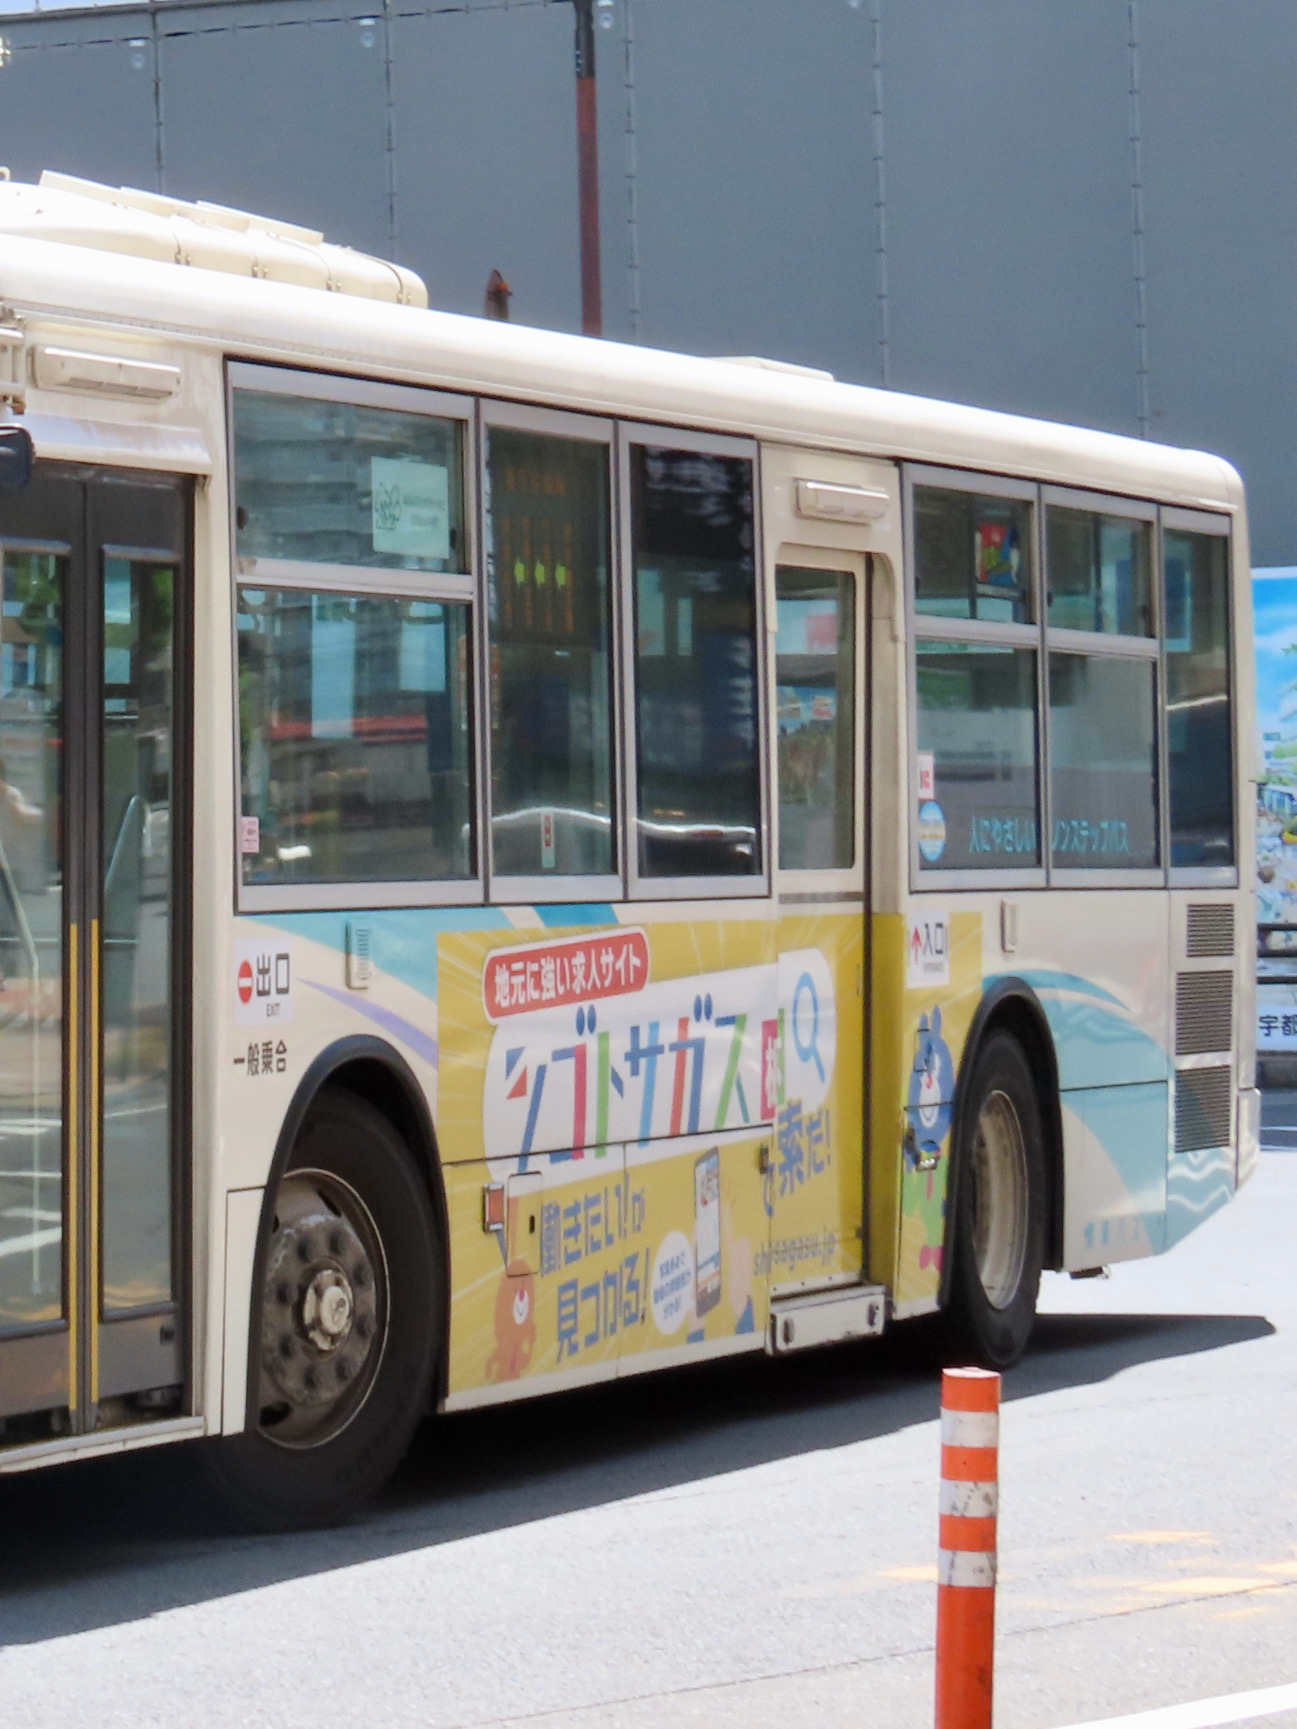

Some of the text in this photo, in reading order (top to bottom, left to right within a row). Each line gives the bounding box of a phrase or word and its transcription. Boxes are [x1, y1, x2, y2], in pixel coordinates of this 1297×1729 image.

[923, 922, 944, 956] 入口
[256, 953, 290, 997] 出口
[494, 942, 642, 1008] 地元に強い求人サイト
[266, 1003, 281, 1018] EXIT
[233, 1040, 288, 1077] 一般乗合
[505, 992, 751, 1180] シゴトサガス
[556, 1247, 650, 1364] 見つかる!
